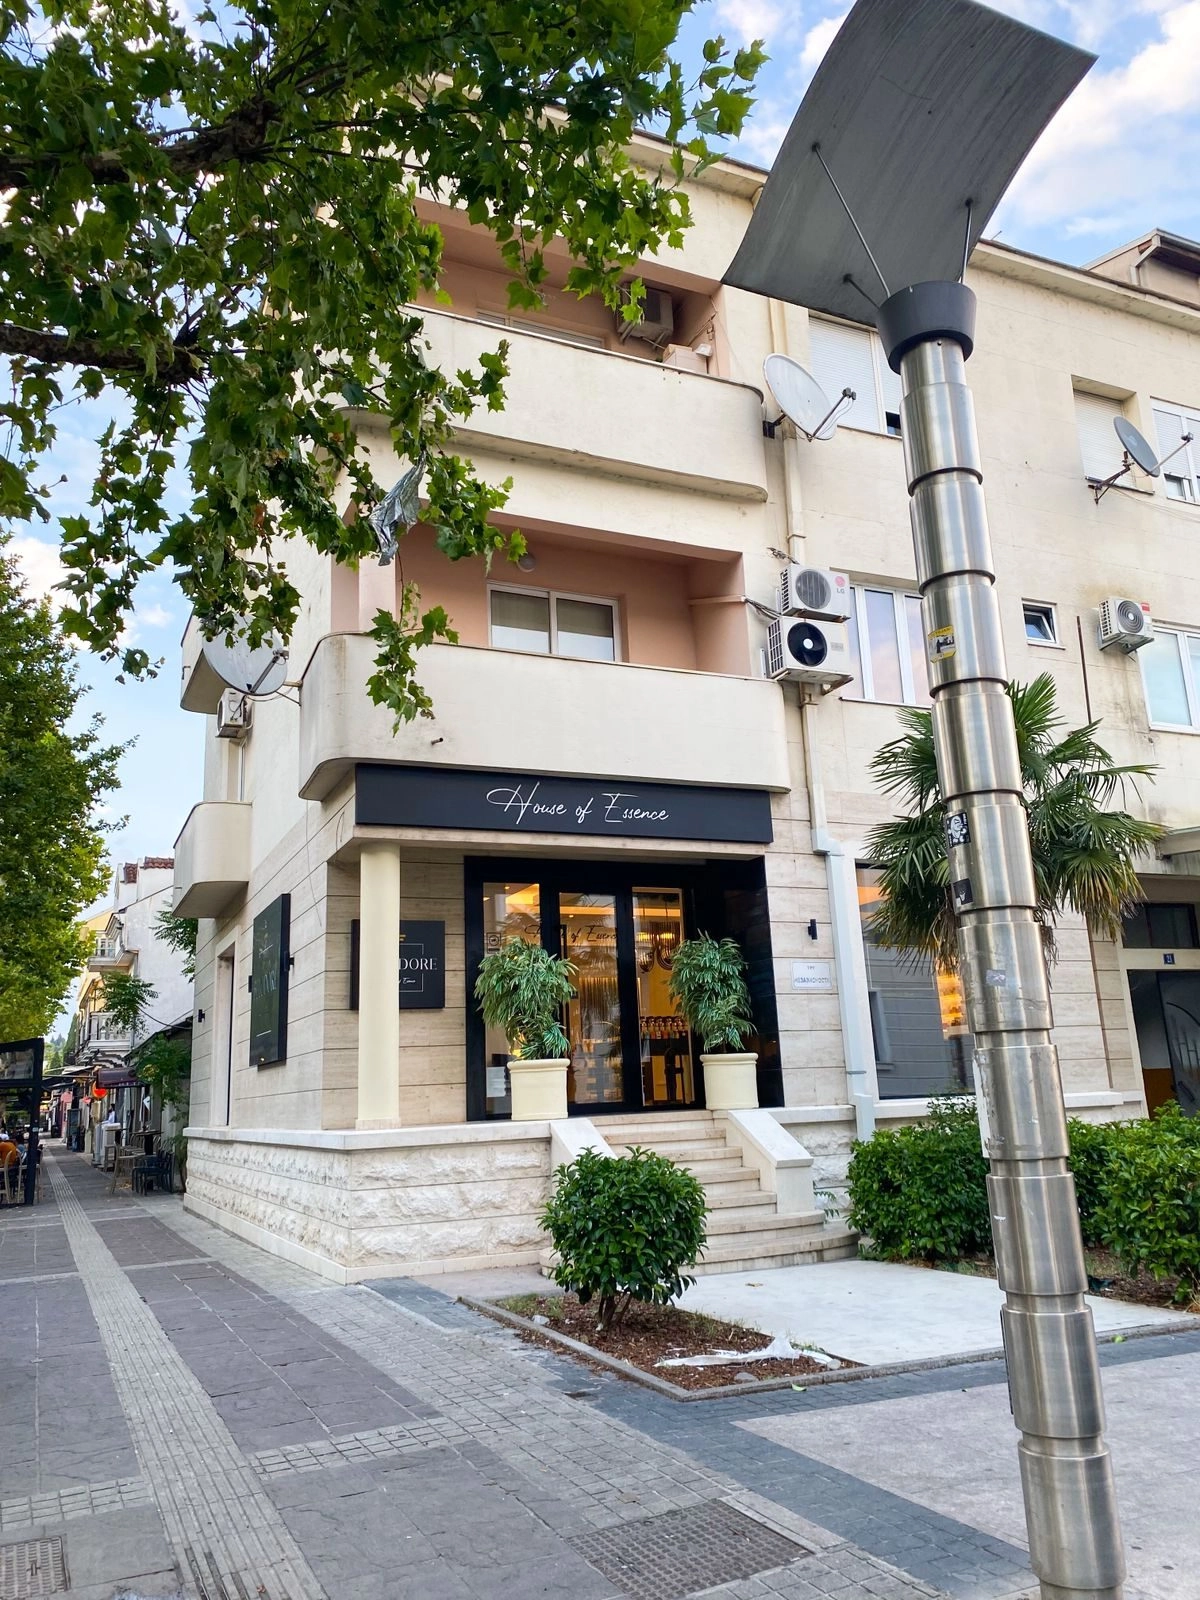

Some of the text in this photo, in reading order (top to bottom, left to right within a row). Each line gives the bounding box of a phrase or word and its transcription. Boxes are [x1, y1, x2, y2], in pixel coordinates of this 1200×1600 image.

[486, 781, 670, 825] House of Essence
[399, 958, 438, 970] DORE
